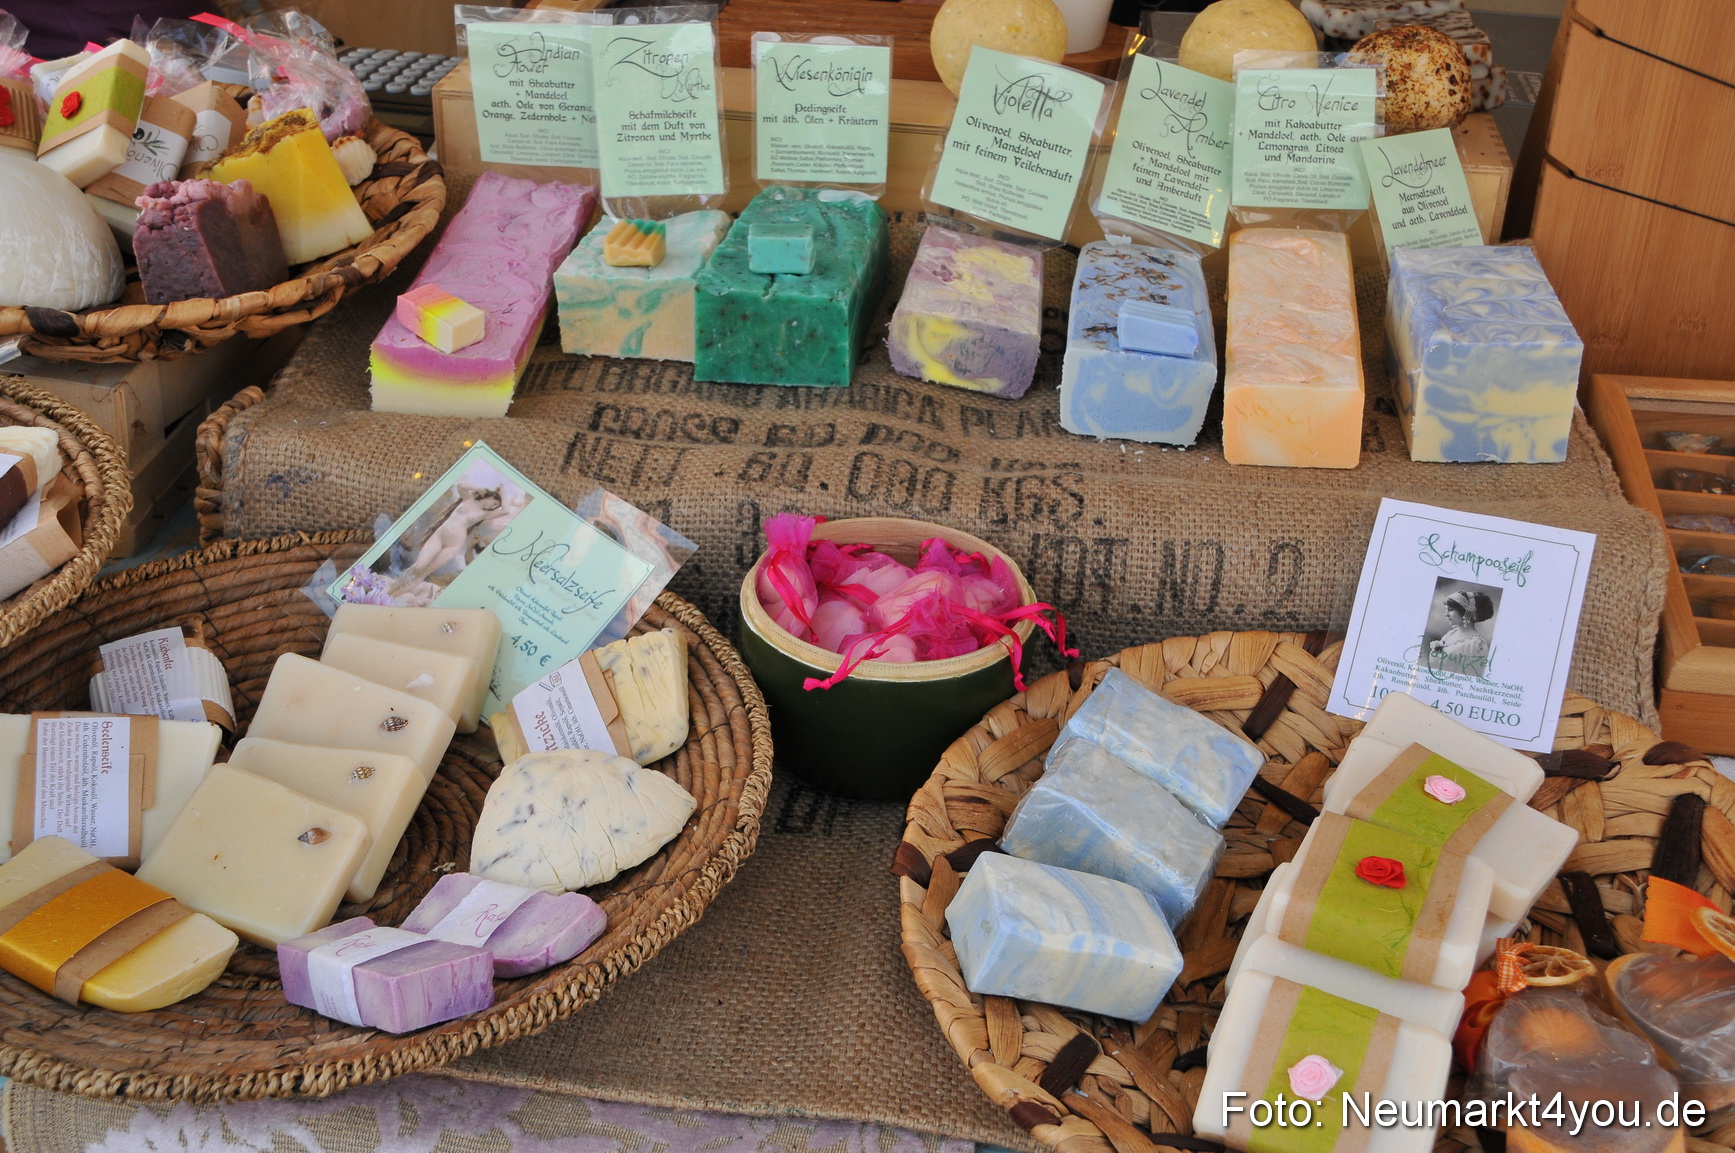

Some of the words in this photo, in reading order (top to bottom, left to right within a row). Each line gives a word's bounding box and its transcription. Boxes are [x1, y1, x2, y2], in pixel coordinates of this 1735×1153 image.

[529, 32, 580, 63] Indian
[528, 79, 575, 89] Sheabutter
[766, 55, 873, 97] Wiesenkönigin
[993, 68, 1073, 122] Violetta
[1140, 62, 1207, 121] Lavendel
[1256, 74, 1296, 111] Citro
[1303, 73, 1359, 117] Venice
[491, 100, 511, 109] aeth.
[516, 101, 534, 110] Oele
[520, 111, 566, 122] Zedernholz
[629, 110, 697, 120] Schafmilchseife
[795, 104, 847, 115] Peelingseife
[622, 122, 636, 131] mit
[641, 122, 659, 130] dem
[664, 121, 684, 130] Duft
[689, 122, 705, 130] von
[762, 115, 778, 123] mit
[783, 115, 799, 124] äth.
[838, 115, 879, 126] Kräutern
[1265, 119, 1280, 128] mit
[617, 133, 655, 142] Zitronen
[660, 132, 675, 141] und
[680, 132, 711, 143] Myrthe
[991, 136, 1041, 160] Mandeloel
[1300, 132, 1321, 141] aeth.
[1327, 132, 1346, 142] Oele
[1315, 143, 1344, 153] Litsea
[952, 139, 971, 151] mit
[975, 145, 1008, 163] feinem
[1014, 155, 1073, 183] Veilchenduft
[1132, 162, 1160, 179] feinem
[1149, 156, 1191, 177] Mandeloel
[1194, 172, 1209, 183] mit
[1177, 154, 1222, 176] Sheabutter
[1265, 153, 1281, 162] und
[1286, 153, 1336, 165] Mandarine
[1377, 146, 1447, 189] Lavendelmeer
[1136, 175, 1152, 187] und
[1157, 181, 1202, 203] Amberduft
[1399, 185, 1445, 205] Meersalzseife
[1392, 218, 1406, 230] und
[1409, 214, 1427, 226] aeth.
[1428, 204, 1468, 222] Lavendeloel
[1401, 206, 1415, 215] aus
[1416, 196, 1449, 211] Olivenoel
[492, 528, 616, 614] Meersalzseife
[1418, 533, 1534, 588] Schampooseife
[158, 637, 172, 670] Küchenfee
[511, 635, 538, 657] 4,50
[540, 654, 551, 667] €
[1403, 635, 1497, 681] Rapunzel
[1374, 664, 1419, 680] Kakaobutter,
[1424, 674, 1463, 689] Sheabutter,
[1469, 683, 1523, 701] Nachtkerzenöl,
[1376, 656, 1406, 669] Olivenöl,
[1474, 676, 1500, 688] Wasser,
[1501, 682, 1525, 693] NaOH,
[1436, 685, 1450, 694] äth.
[1455, 689, 1496, 703] Patchouliöl,
[1501, 698, 1521, 708] Seide
[1468, 704, 1521, 728] EURO
[90, 721, 99, 749] Olivenöl,
[534, 711, 558, 751] tzicke
[99, 720, 113, 774] Seelenseife
[90, 750, 98, 773] Rapsöl,
[89, 774, 98, 801] Kokosöl,
[89, 802, 97, 825] Wasser,
[88, 827, 96, 848] NaOH,
